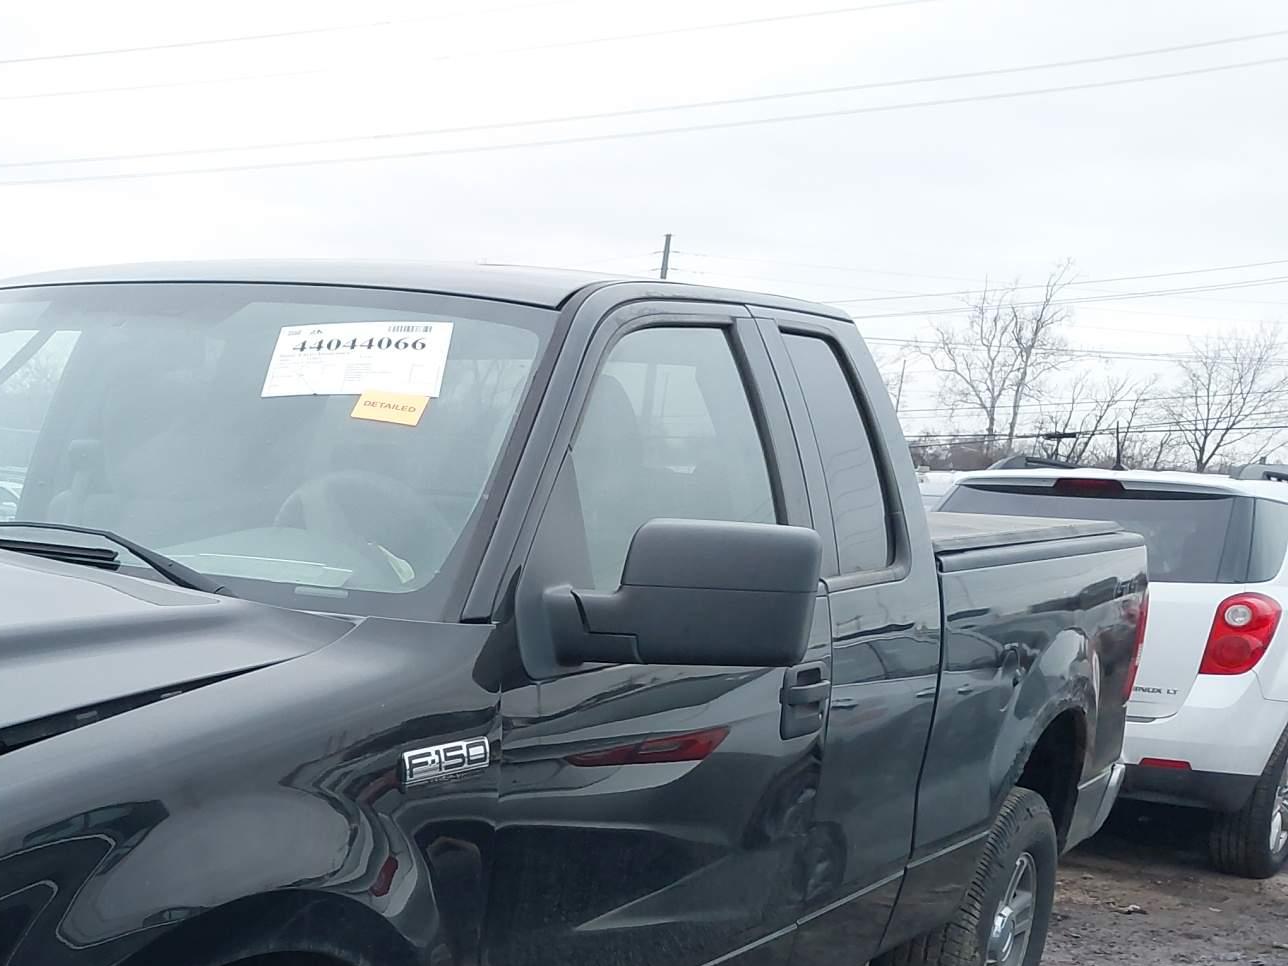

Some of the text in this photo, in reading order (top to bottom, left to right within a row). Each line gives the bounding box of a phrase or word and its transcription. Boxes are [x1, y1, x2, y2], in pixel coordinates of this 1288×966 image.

[292, 336, 427, 352] 44044066
[363, 400, 416, 413] DETAILED
[406, 740, 489, 779] F-150
